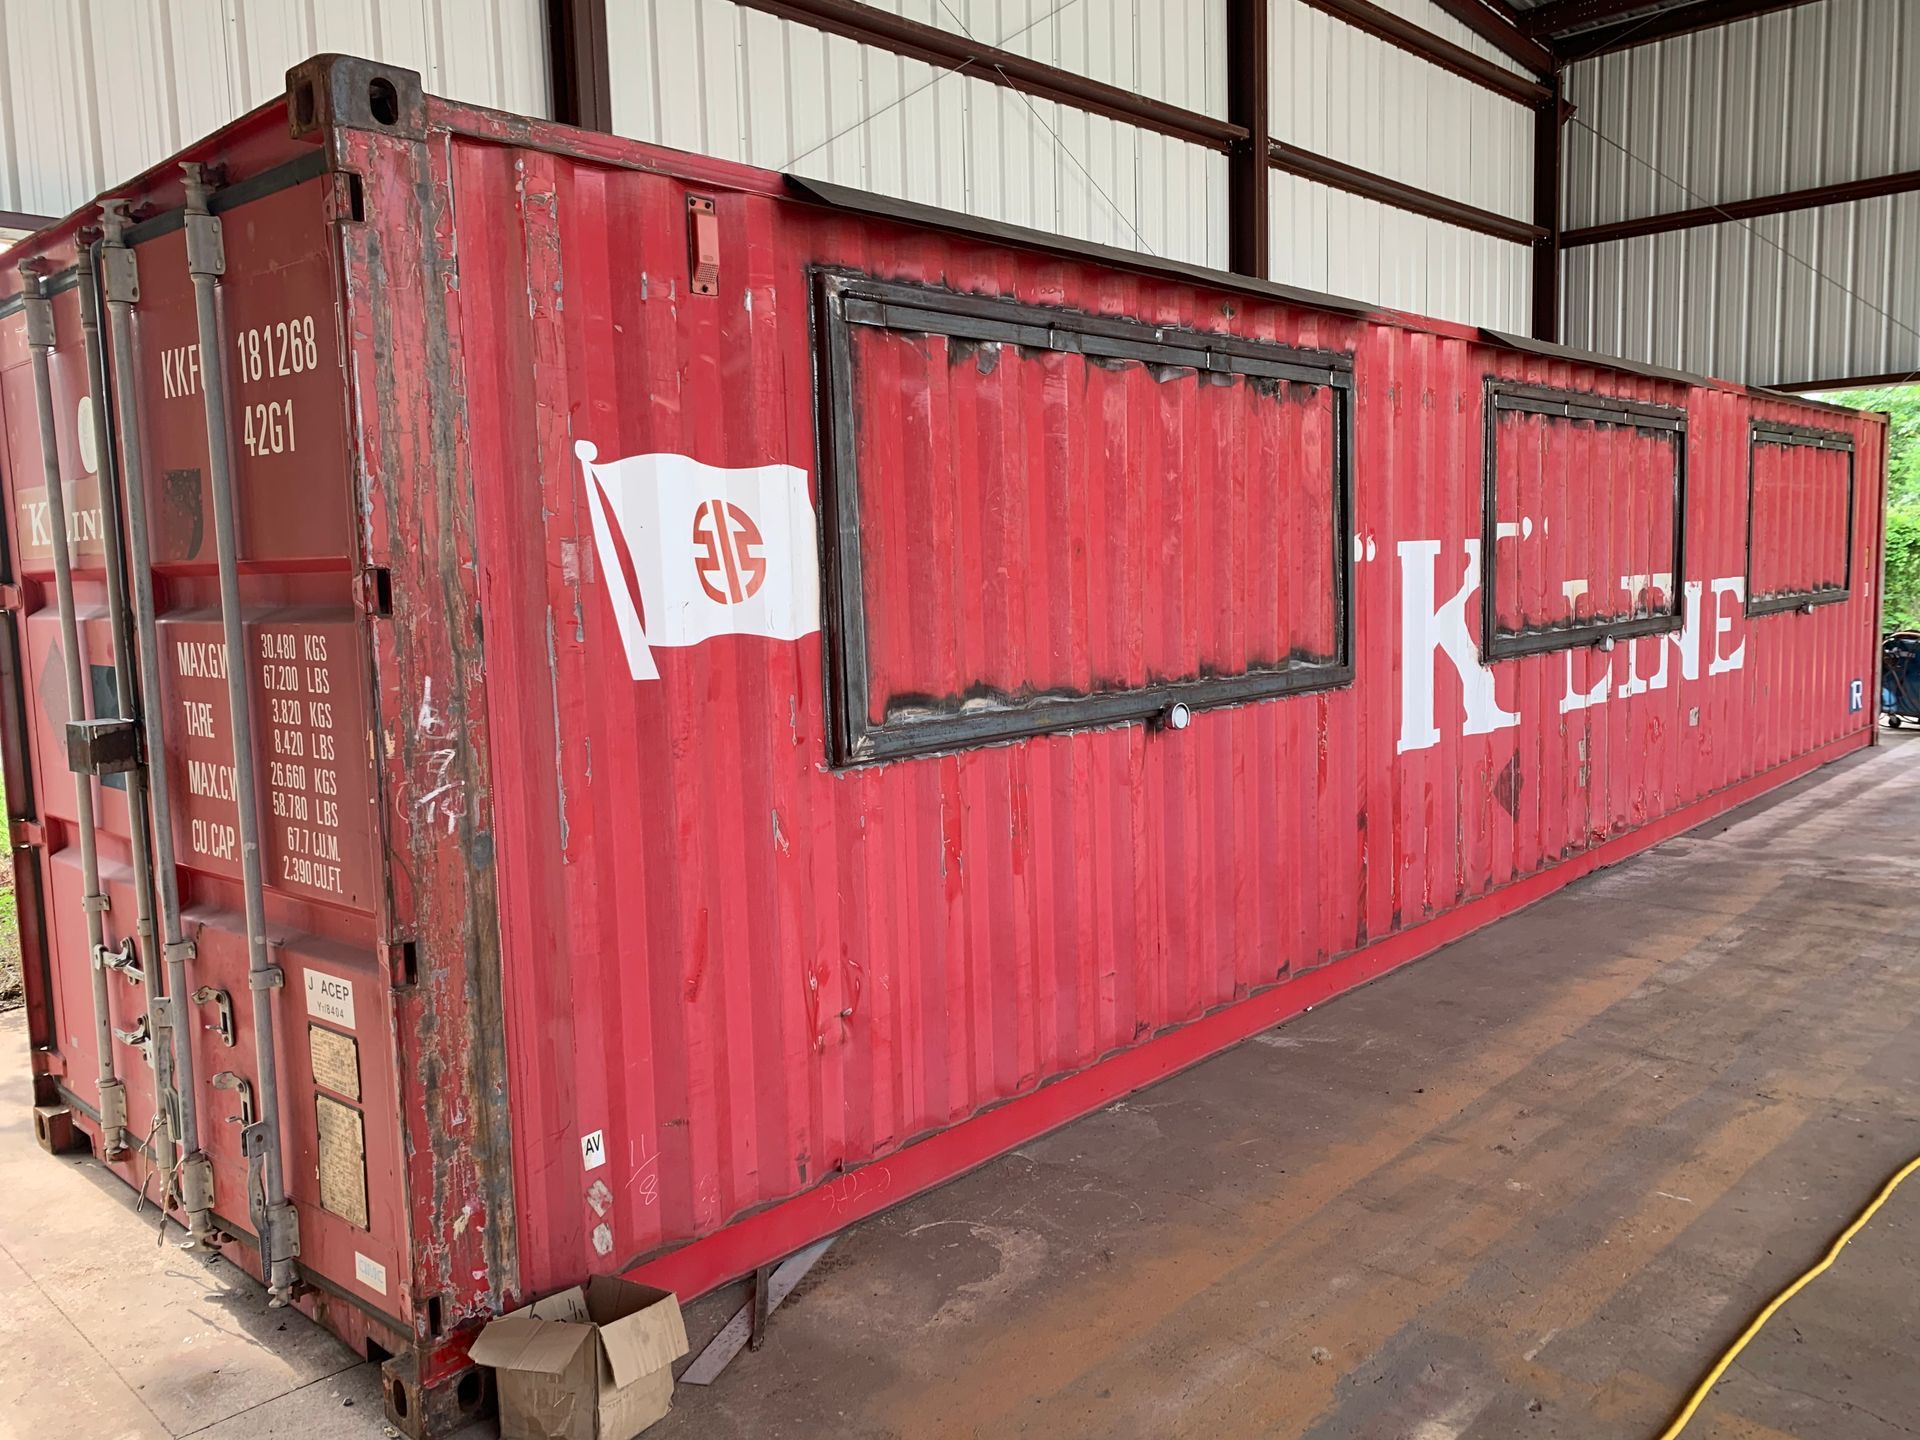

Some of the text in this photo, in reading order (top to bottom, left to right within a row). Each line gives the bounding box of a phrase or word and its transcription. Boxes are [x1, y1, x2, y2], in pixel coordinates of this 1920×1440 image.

[161, 315, 317, 399] KKF 181268
[244, 399, 295, 457] 42G1
[304, 634, 327, 661] KGS
[306, 666, 330, 694] LBS
[184, 701, 215, 738] TARE
[309, 701, 333, 729] KGS
[312, 732, 335, 760] LBS
[314, 767, 337, 796] KGS
[316, 798, 338, 827] LBS
[321, 980, 349, 1001] ACEP
[586, 1134, 601, 1156] AV
